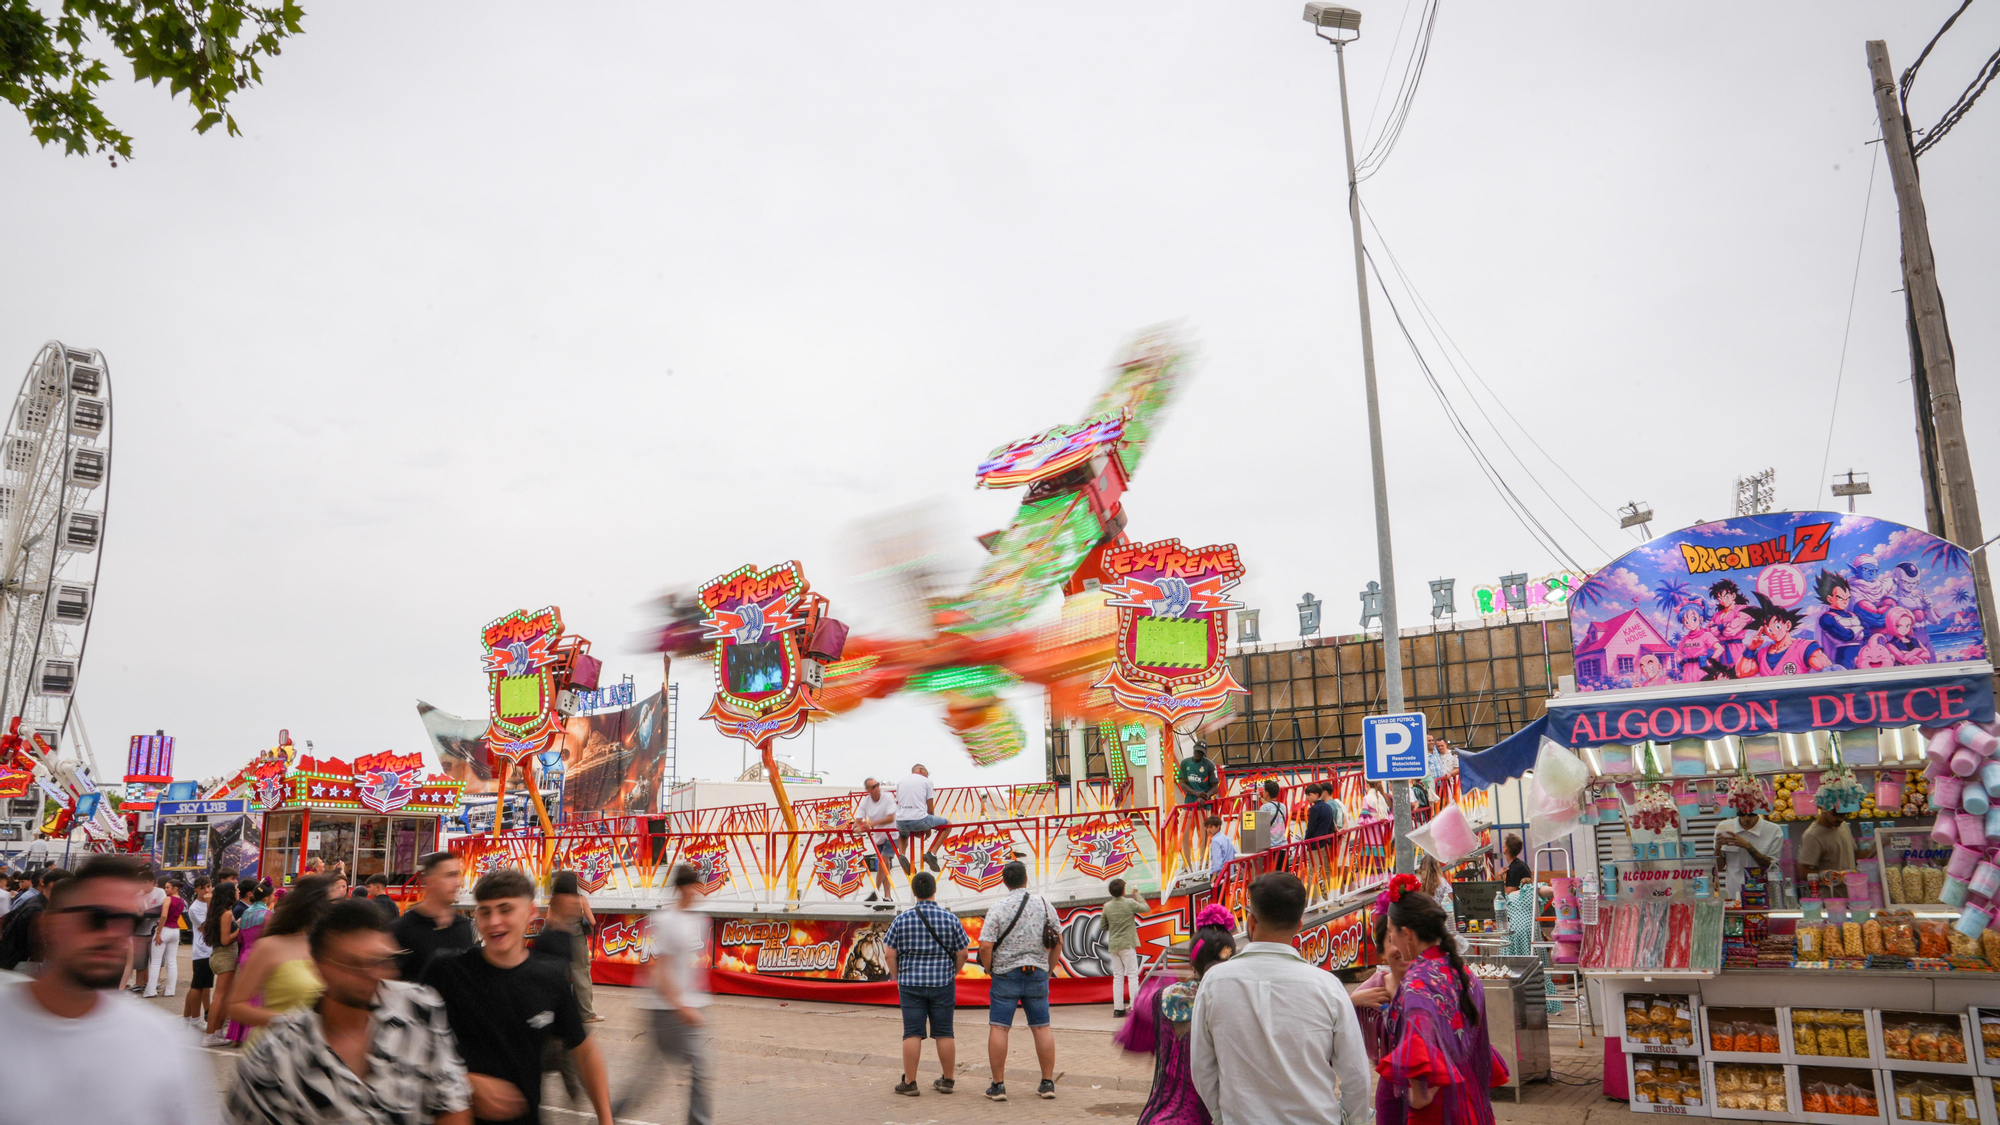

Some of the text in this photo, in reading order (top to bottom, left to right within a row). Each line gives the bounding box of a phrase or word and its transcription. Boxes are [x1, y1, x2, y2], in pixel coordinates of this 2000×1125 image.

[1790, 521, 1835, 565] Z
[1111, 546, 1239, 579] EXTREME
[702, 569, 798, 608] EXTREME
[484, 612, 555, 645] EXTREME
[1622, 622, 1643, 637] KAME
[1624, 629, 1648, 645] HOUSE
[1570, 685, 1971, 744] ALGODÓN DULCE
[1375, 722, 1412, 773] P
[356, 749, 423, 773] EXTREME
[176, 801, 228, 814] SKY LAB
[817, 800, 852, 814] EXTREME
[944, 829, 1013, 853] EXTREME
[1068, 818, 1134, 843] EXTREME
[573, 842, 611, 861] EXTREME
[684, 839, 727, 859] EXTREME
[815, 837, 865, 860] EXTREME
[1623, 868, 1704, 882] ALGODON DULCE
[721, 920, 790, 946] NOVEDAD
[764, 937, 783, 950] DEL
[757, 940, 841, 971] MILENIO!
